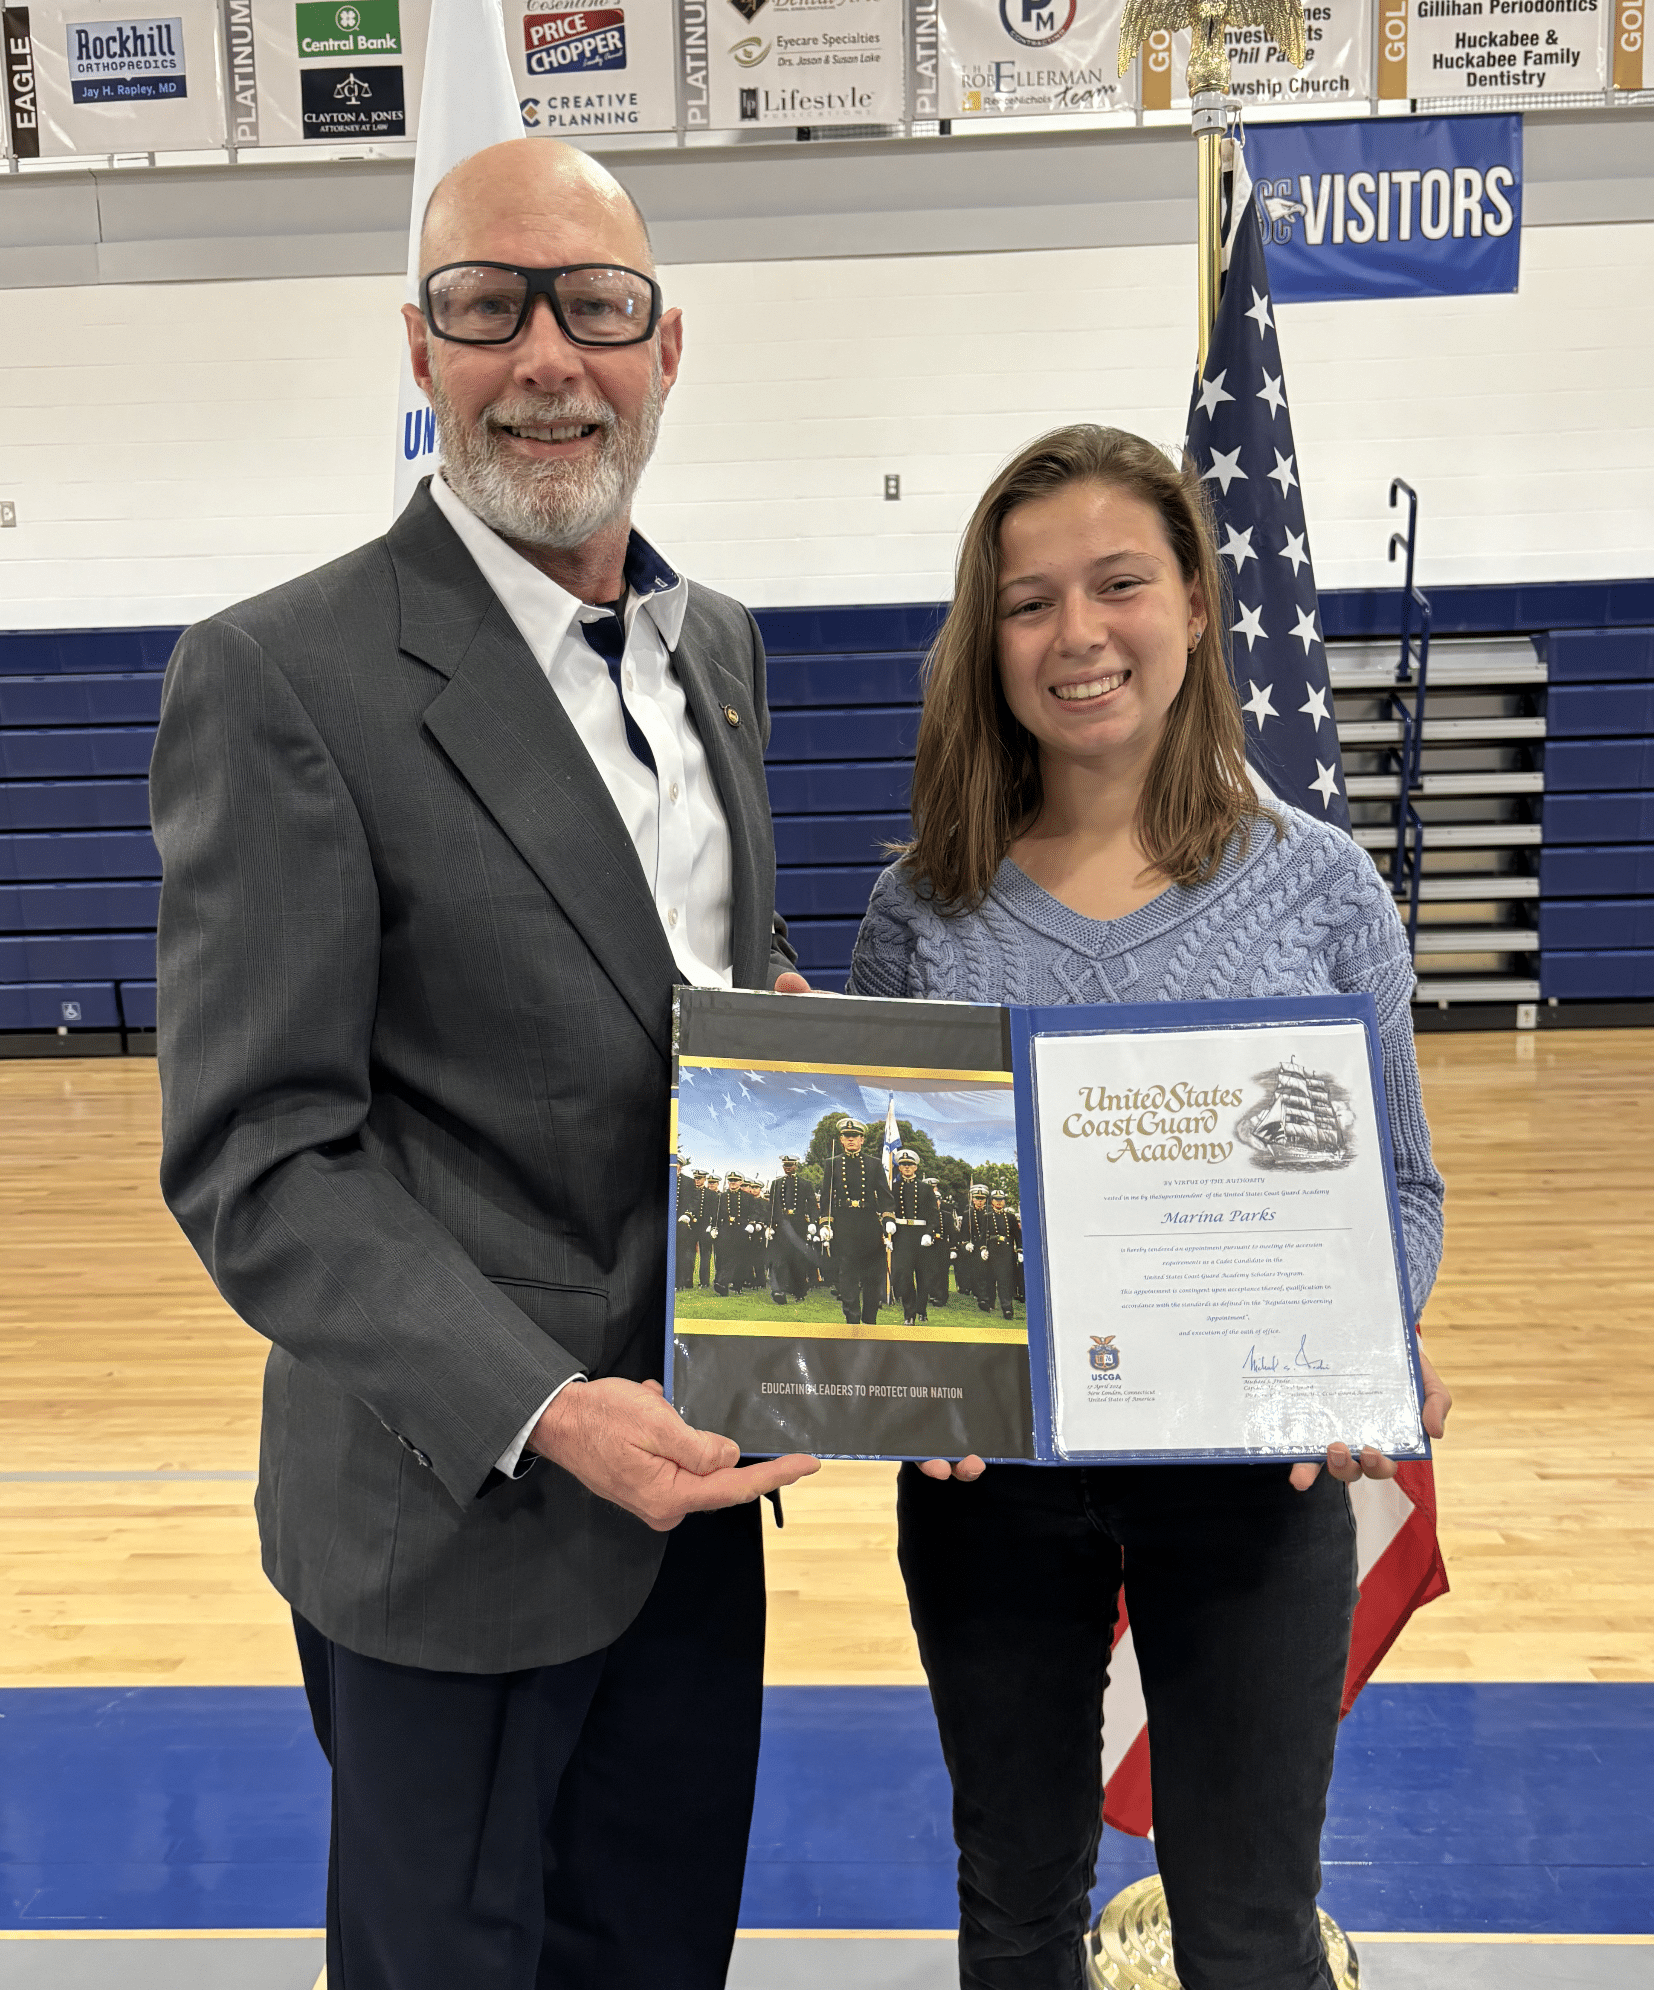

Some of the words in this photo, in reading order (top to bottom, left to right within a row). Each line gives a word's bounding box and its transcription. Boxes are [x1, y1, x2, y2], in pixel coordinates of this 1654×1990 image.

[1304, 7, 1331, 20] nes
[1417, 0, 1483, 18] Gillihan
[1489, 0, 1598, 14] Periodontics
[530, 13, 588, 46] PRICE
[1387, 0, 1406, 62] GOL
[1619, 0, 1643, 53] GOL
[75, 24, 175, 60] Rockhill
[302, 34, 353, 52] Central
[357, 33, 397, 49] Bank
[777, 35, 819, 50] Eyecare
[821, 32, 880, 47] Specialties
[1455, 31, 1539, 48] Huckabee
[1545, 29, 1558, 45] &
[530, 30, 623, 73] CHOPPER
[777, 57, 794, 66] Drs.
[796, 56, 822, 66] Jason
[823, 55, 830, 64] &
[832, 54, 858, 64] Susan
[860, 53, 881, 63] Lake
[916, 0, 936, 114] PLATINU
[1149, 29, 1170, 72] GO
[1228, 48, 1259, 64] Phil
[1265, 47, 1315, 63] Pae
[1433, 54, 1516, 69] Huckabee
[1523, 48, 1580, 66] Family
[78, 59, 176, 73] ORTHOPAEDICS
[229, 0, 257, 141] PLATINUM
[684, 0, 708, 125] PLATINU
[10, 36, 36, 129] EAGLE
[1229, 79, 1282, 97] wship
[1289, 75, 1350, 93] Church
[1466, 69, 1546, 88] Dentistry
[82, 87, 99, 98] Jay
[102, 86, 114, 95] H.
[117, 84, 156, 97] Rapley,
[158, 83, 176, 93] MD
[764, 87, 872, 111] Lifestyle
[547, 93, 638, 109] CREATIVE
[304, 112, 356, 123] CLAYTON
[358, 112, 369, 121] A.
[371, 110, 403, 122] JONES
[548, 111, 639, 127] PLANNING
[320, 124, 360, 133] ATTORNEY
[1299, 166, 1515, 246] VISITORS
[404, 406, 436, 460] UN
[1078, 1085, 1166, 1111] United
[1164, 1082, 1243, 1113] States
[1062, 1113, 1136, 1138] Coast
[1137, 1109, 1218, 1135] Guard
[1106, 1136, 1233, 1164] Academy
[1205, 1191, 1212, 1199] of
[1281, 1189, 1301, 1197] Guard
[1301, 1188, 1330, 1196] Academy
[1160, 1210, 1224, 1224] Marina
[1229, 1207, 1276, 1222] Parks
[1184, 1245, 1222, 1253] appointment
[1091, 1373, 1122, 1381] USCGA
[814, 1383, 853, 1396] LEADERS
[855, 1384, 866, 1397] TO
[868, 1385, 908, 1398] PROTECT
[909, 1386, 929, 1398] OUR
[930, 1387, 963, 1399] NATION
